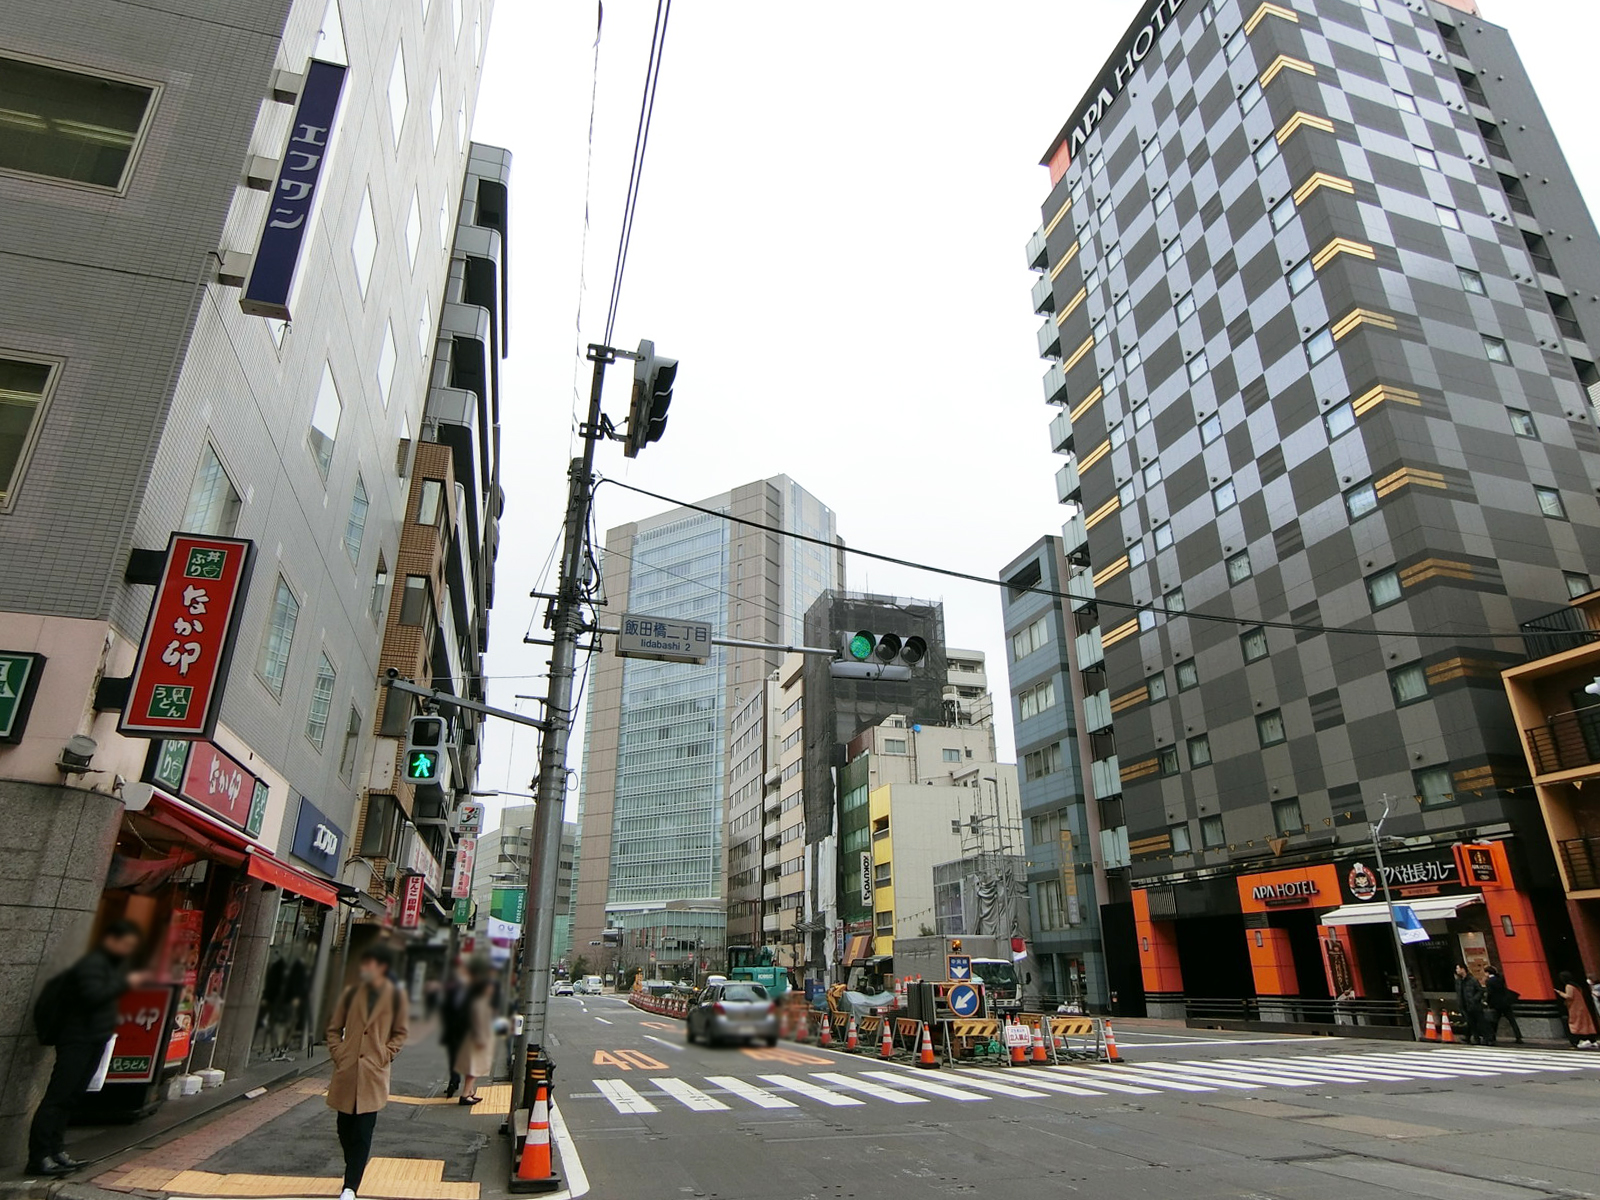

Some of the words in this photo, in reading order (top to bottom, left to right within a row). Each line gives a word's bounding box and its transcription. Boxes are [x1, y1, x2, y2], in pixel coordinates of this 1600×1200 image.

[1071, 88, 1113, 157] APA
[269, 123, 328, 230] エフワン
[162, 584, 210, 677] なか卯
[625, 619, 707, 642] 飯田橋二丁目
[641, 639, 680, 651] Iidabashi
[685, 643, 691, 652] 2
[156, 687, 181, 717] うどん
[208, 752, 243, 811] なか卯
[862, 855, 872, 892] KOKUYO
[1377, 861, 1455, 885] アパ社長カレー
[410, 877, 420, 897] はんこ
[1252, 885, 1275, 900] APA
[1276, 880, 1318, 897] HOTEL
[122, 1060, 148, 1070] うどん
[593, 1049, 669, 1070] 40
